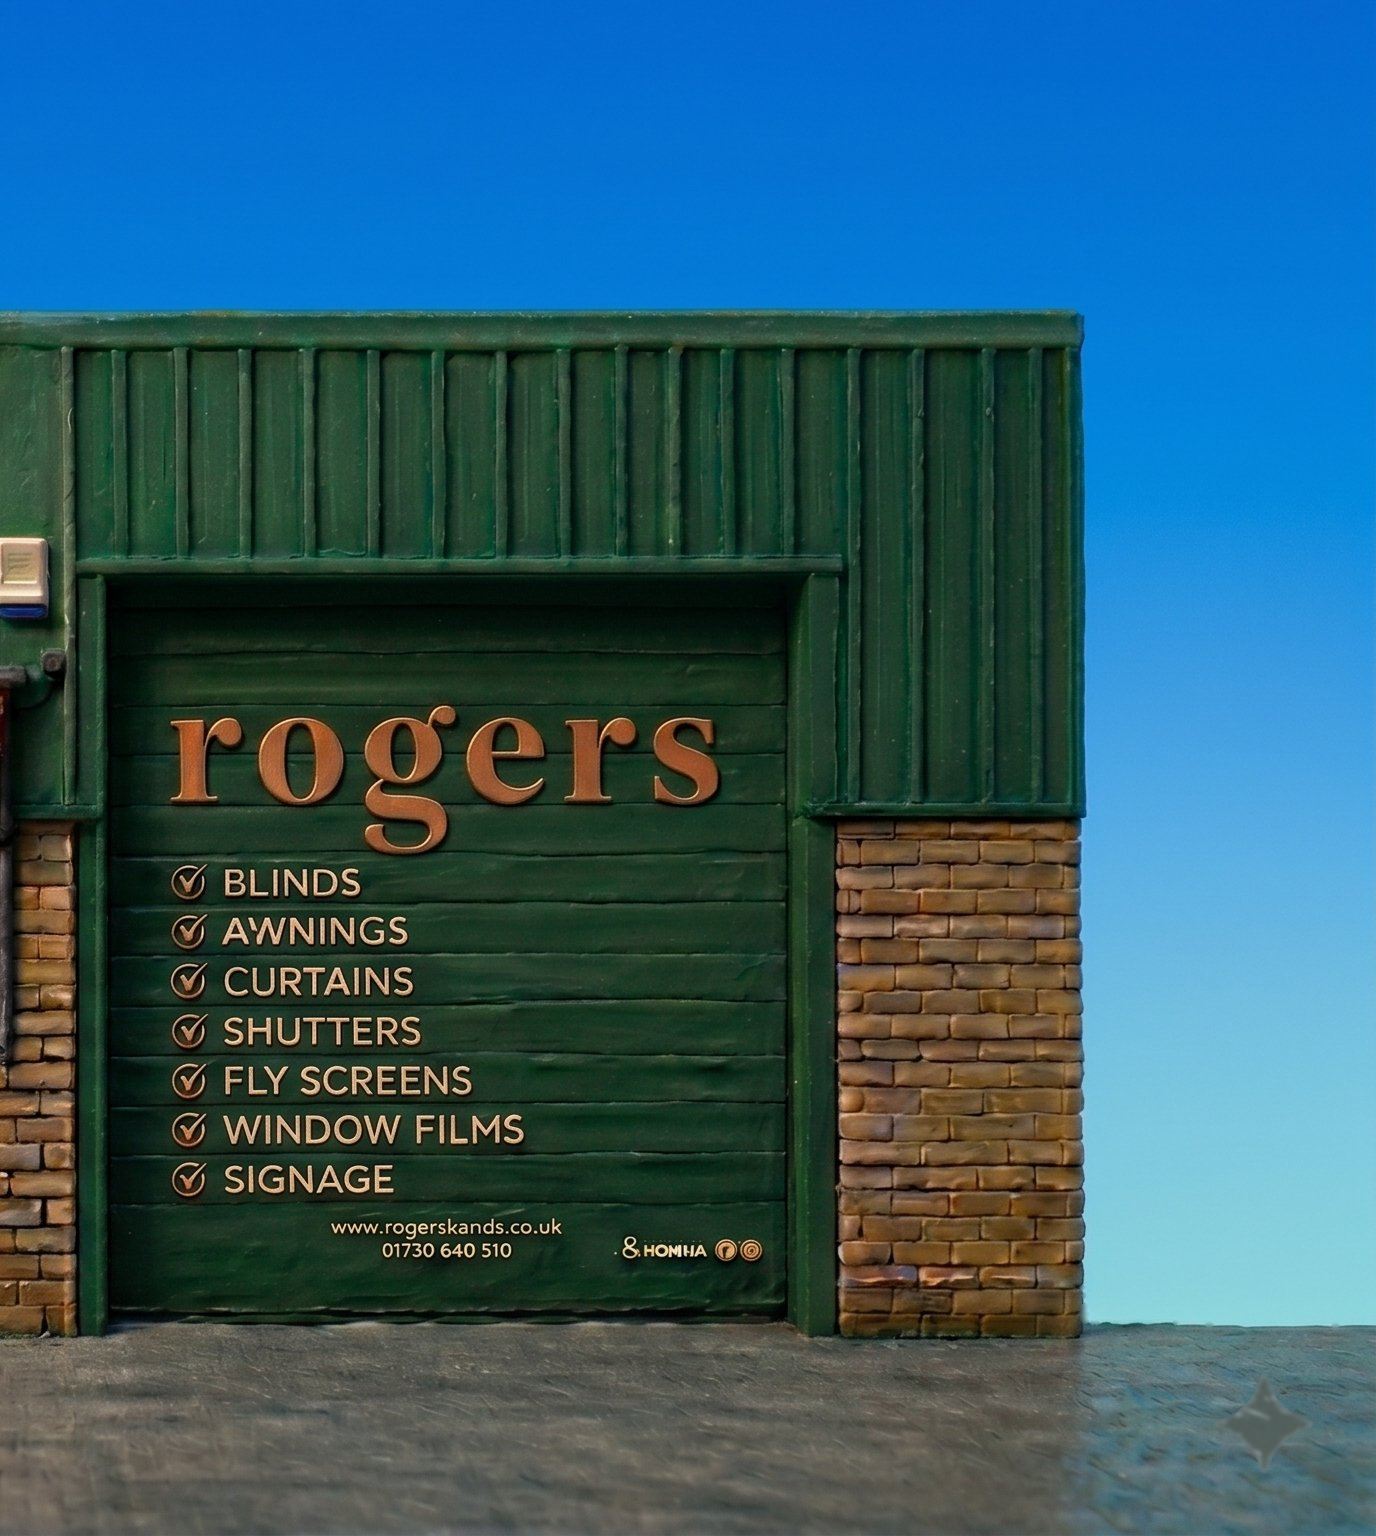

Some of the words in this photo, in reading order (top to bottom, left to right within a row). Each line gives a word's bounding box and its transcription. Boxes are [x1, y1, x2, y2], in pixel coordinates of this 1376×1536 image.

[169, 705, 720, 854] rogers
[224, 868, 361, 897] BLINDS
[222, 916, 408, 946] AWNINGS
[224, 967, 414, 997] CURTAINS
[224, 1017, 421, 1047] SHUTTERS
[224, 1066, 289, 1095] FLY
[300, 1066, 472, 1096] SCREENS
[223, 1115, 401, 1145] WINDOW
[416, 1115, 525, 1145] FILMS
[224, 1165, 394, 1195] SIGNAGE
[331, 1218, 562, 1240] www.rogerskands.co.uk
[382, 1243, 435, 1259] 01730
[440, 1243, 476, 1259] 640
[482, 1243, 512, 1259] 510
